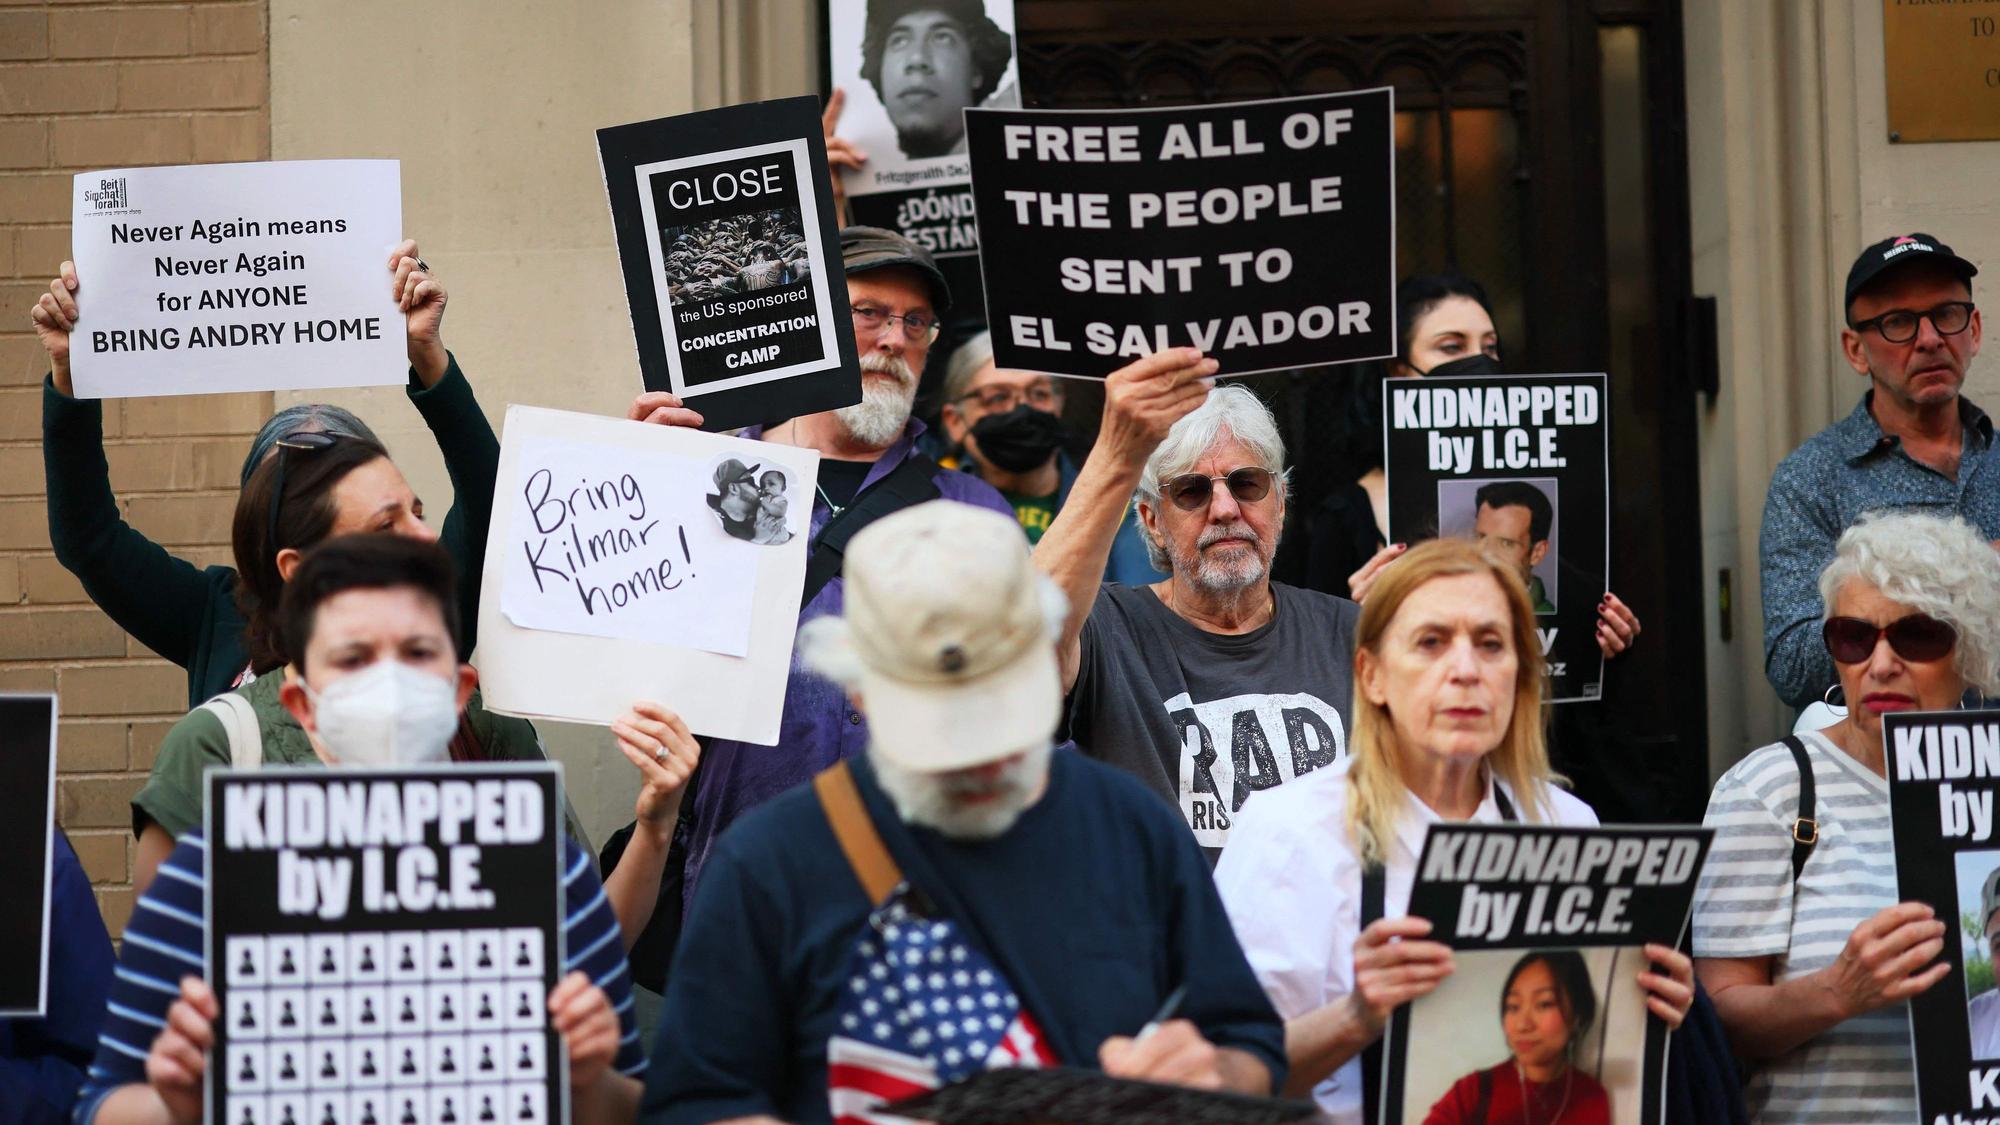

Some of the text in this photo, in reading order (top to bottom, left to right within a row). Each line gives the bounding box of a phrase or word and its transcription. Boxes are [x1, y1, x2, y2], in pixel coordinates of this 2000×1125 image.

[1005, 109, 1352, 161] FREE ALL OF
[84, 190, 119, 201] Simchat
[94, 199, 118, 209] Torah
[101, 179, 118, 190] Beit
[668, 164, 782, 209] CLOSE
[1005, 177, 1341, 228] THE PEOPLE
[112, 217, 346, 244] Never Again means
[155, 251, 304, 276] Never Again
[1061, 249, 1292, 293] SENT TO
[157, 285, 307, 311] for ANYONE
[680, 287, 807, 322] the US sponsored
[93, 318, 380, 352] BRING ANDRY HOME
[681, 315, 816, 352] CONCENTRATION
[1010, 302, 1371, 357] EL SALVADOR
[726, 345, 781, 369] CAMP
[1394, 386, 1598, 430] KIDNAPPED
[1429, 428, 1566, 473] by I.C.E.
[524, 468, 646, 534] Bring
[524, 520, 659, 593] Kilmar
[576, 525, 697, 616] home!
[224, 780, 544, 849] KIDNAPPED
[1939, 783, 1993, 842] by
[1422, 833, 1701, 885] KIDNAPPED
[278, 844, 496, 920] by I.C.E.
[1455, 884, 1633, 941] by I.C.E.
